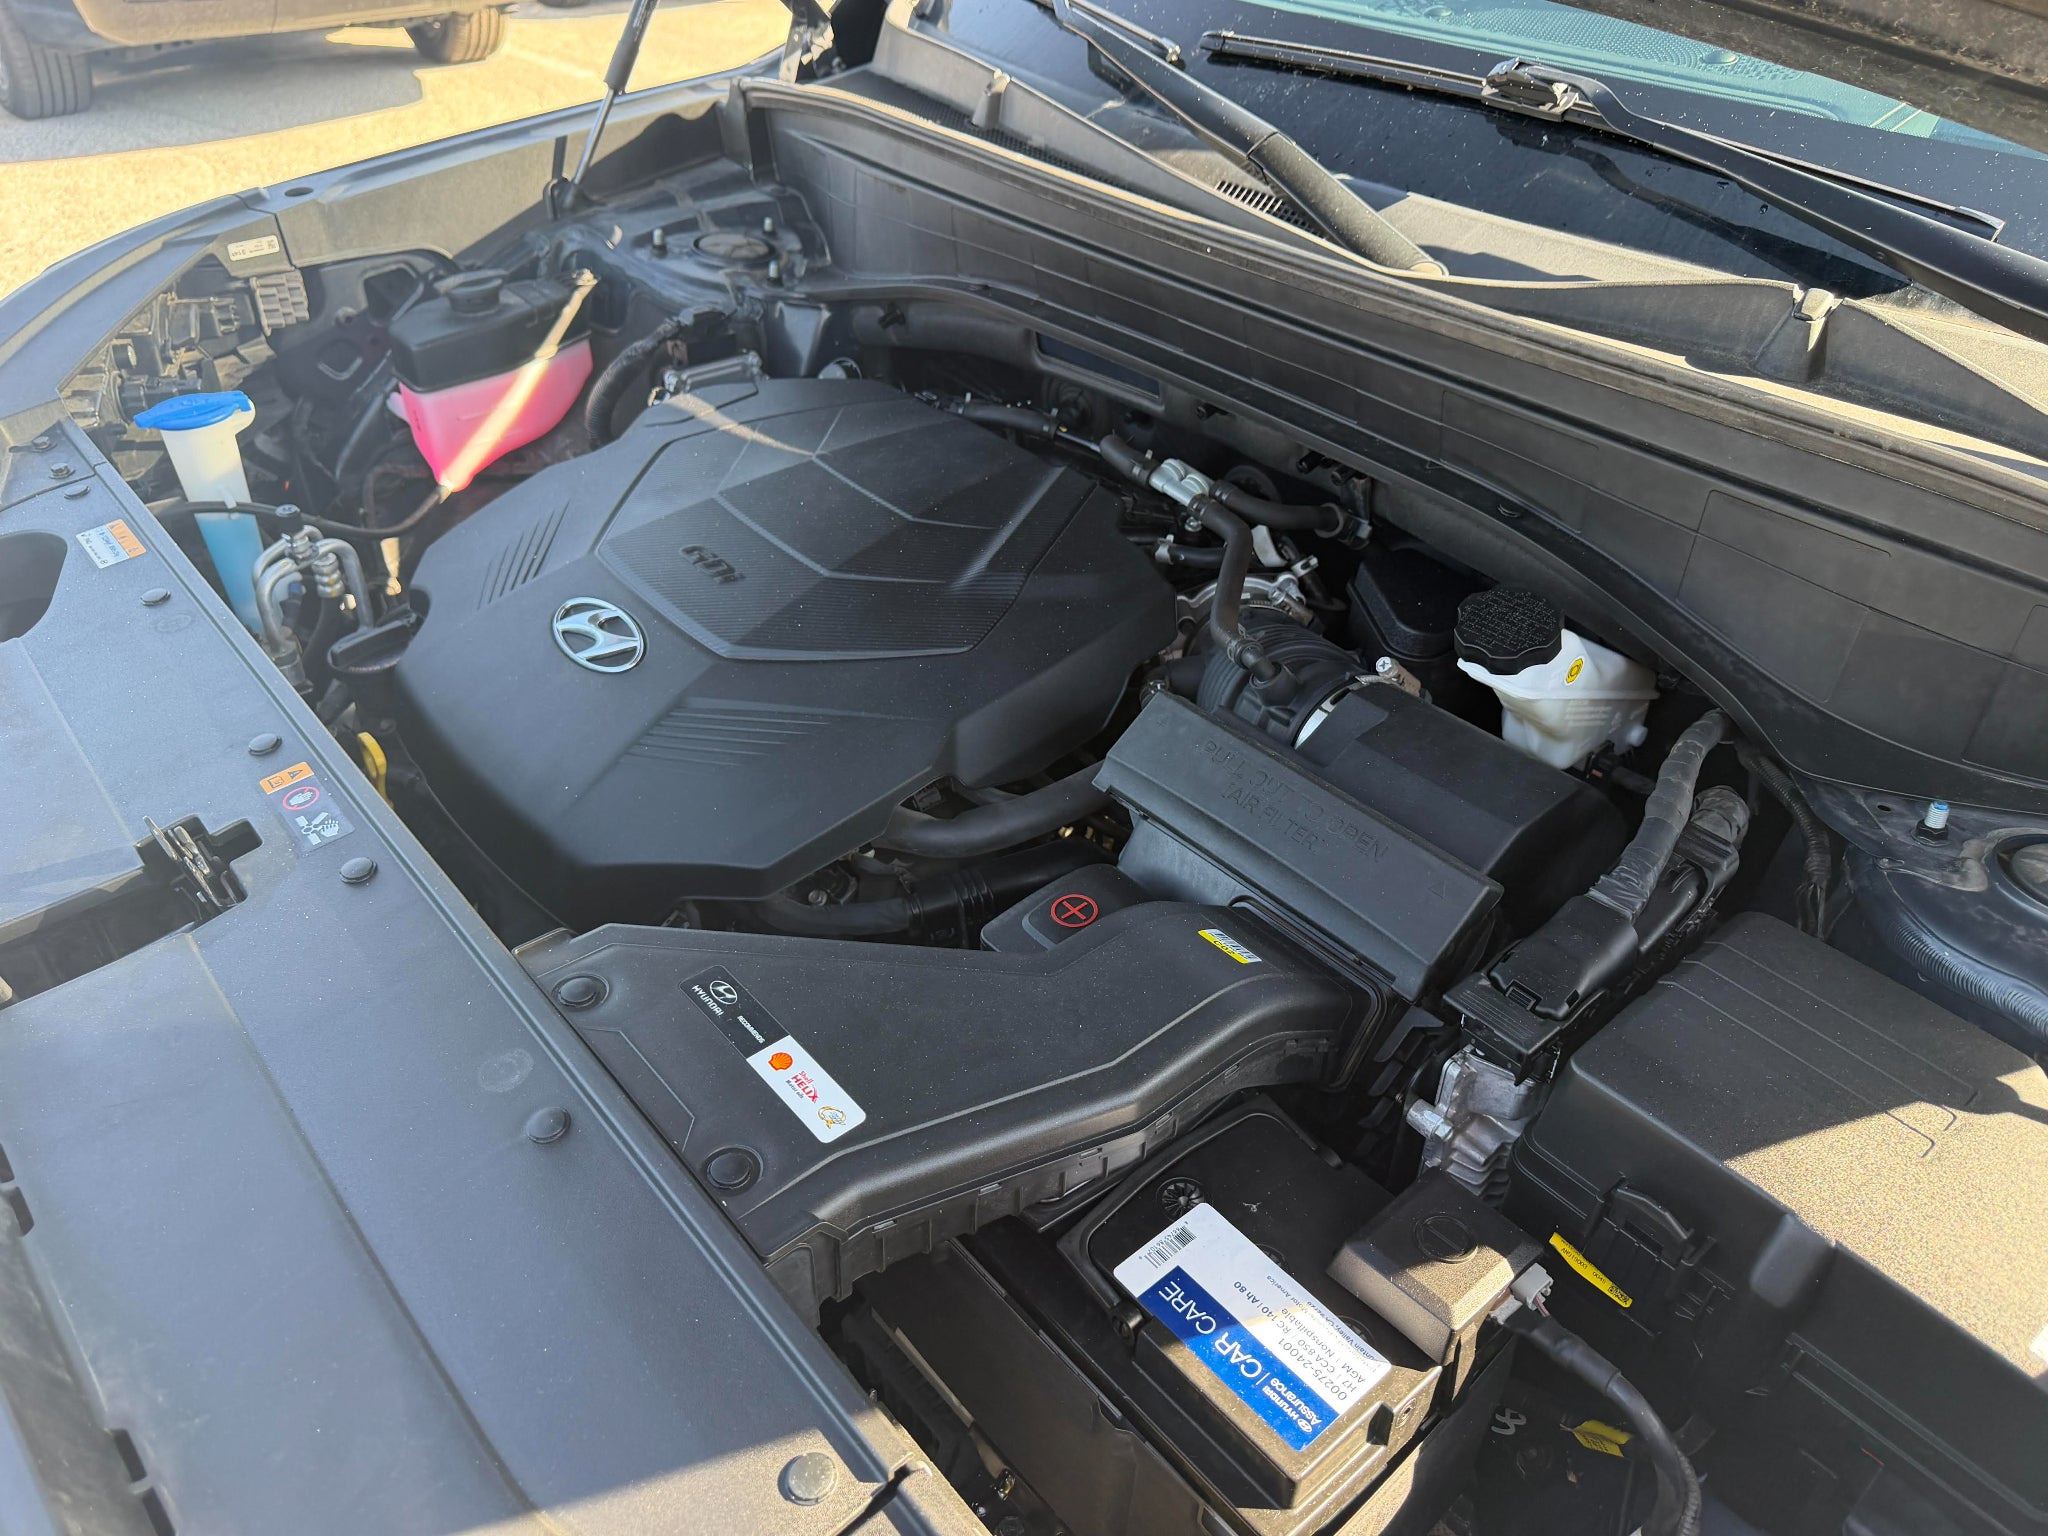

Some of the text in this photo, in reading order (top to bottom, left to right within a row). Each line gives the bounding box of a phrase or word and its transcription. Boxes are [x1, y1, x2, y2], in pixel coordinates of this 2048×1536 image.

[1203, 738, 1245, 780] PULL
[1327, 813, 1390, 863] OPEN
[691, 984, 725, 1017] HYUNDAI
[791, 1074, 820, 1104] HELIX
[798, 1070, 815, 1085] Shell
[1158, 1280, 1217, 1334] CARE
[1214, 1331, 1263, 1379] CAR
[1233, 1280, 1357, 1393] H7 CCA 850 RC 140 Ah 80
[1281, 1308, 1335, 1358] Nonspillable
[1277, 1338, 1347, 1401] 00275-24001
[1341, 1362, 1366, 1383] AGM
[1262, 1386, 1299, 1421] HYUNDAI
[1270, 1377, 1322, 1425] Assurance
